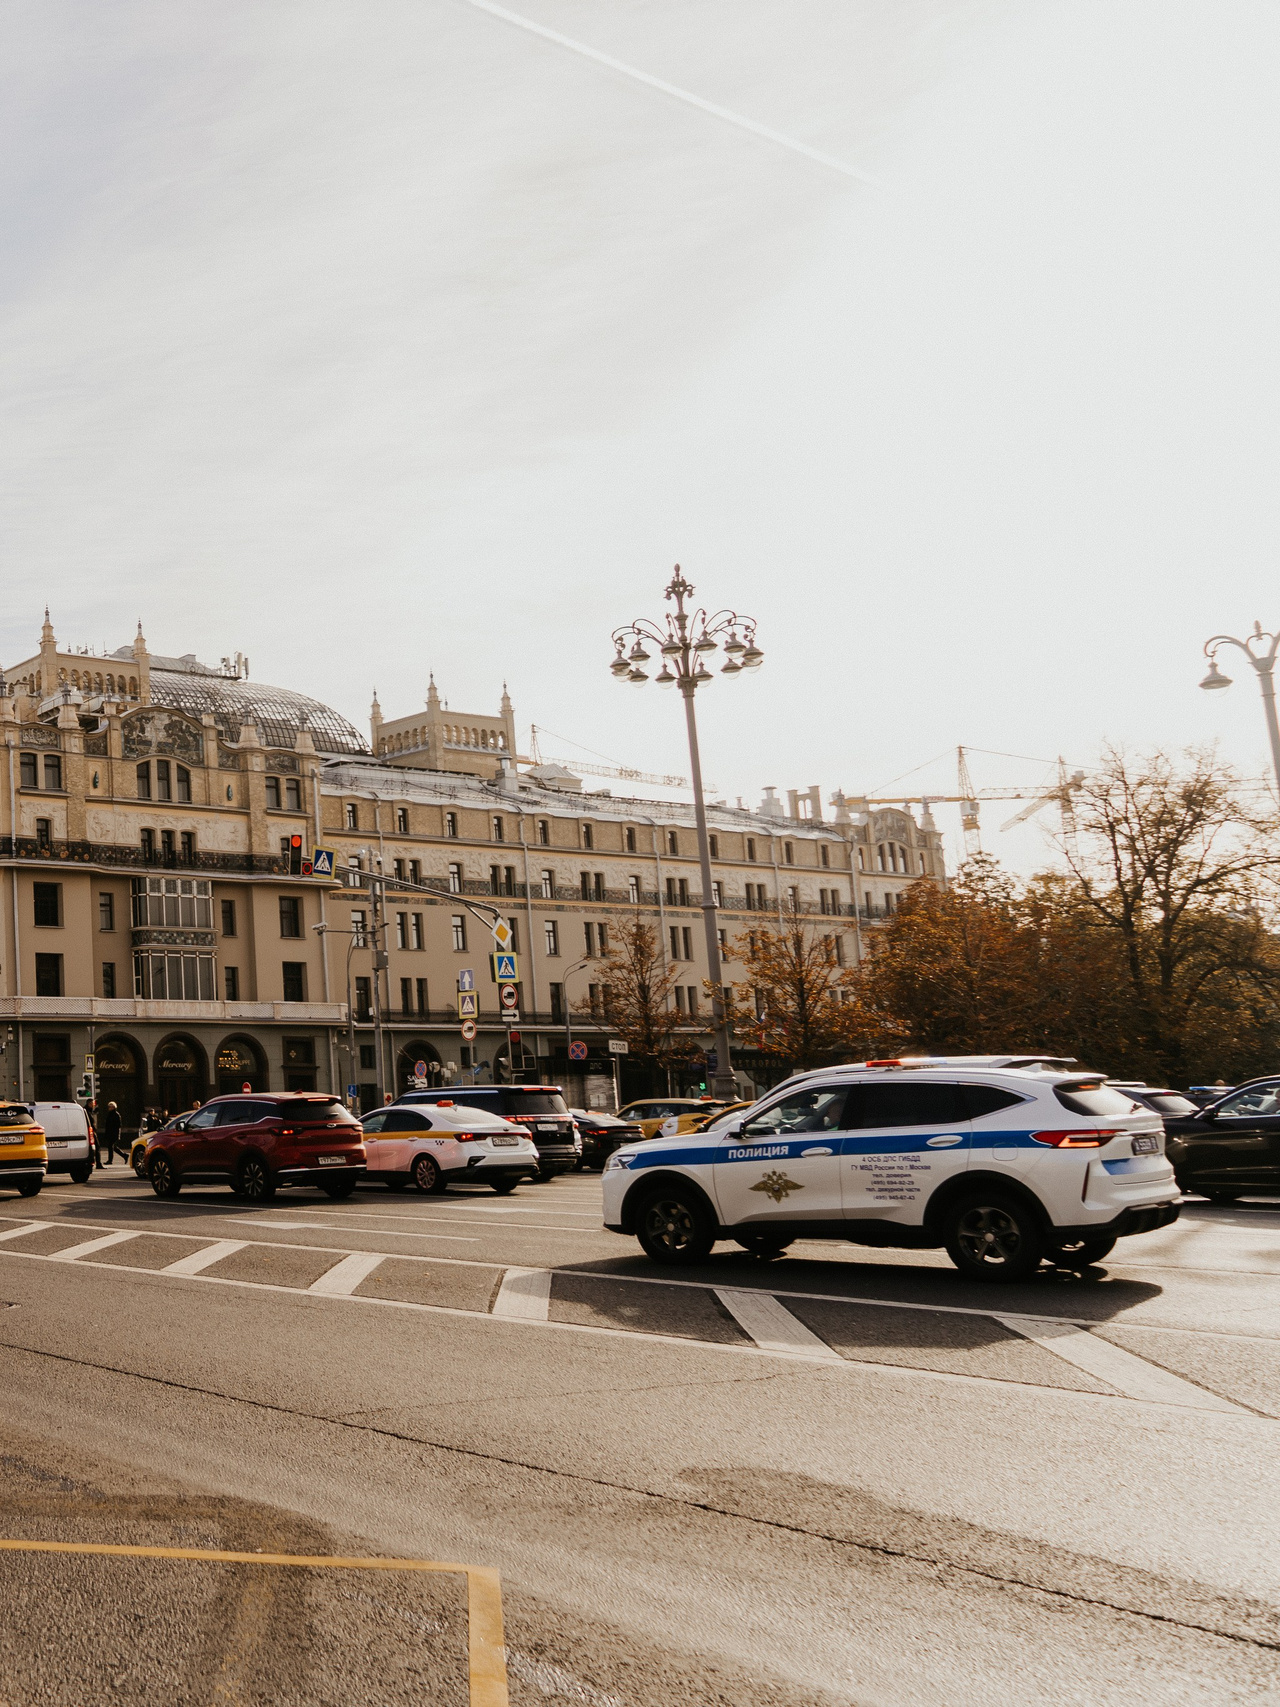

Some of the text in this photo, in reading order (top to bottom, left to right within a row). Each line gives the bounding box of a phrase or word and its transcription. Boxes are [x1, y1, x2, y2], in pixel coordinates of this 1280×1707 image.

[611, 1042, 626, 1051] СТОП
[96, 1060, 130, 1072] Mercury
[159, 1059, 192, 1071] Mercury
[730, 1059, 783, 1068] METROPOL
[728, 1146, 789, 1159] ПОЛИЦИЯ
